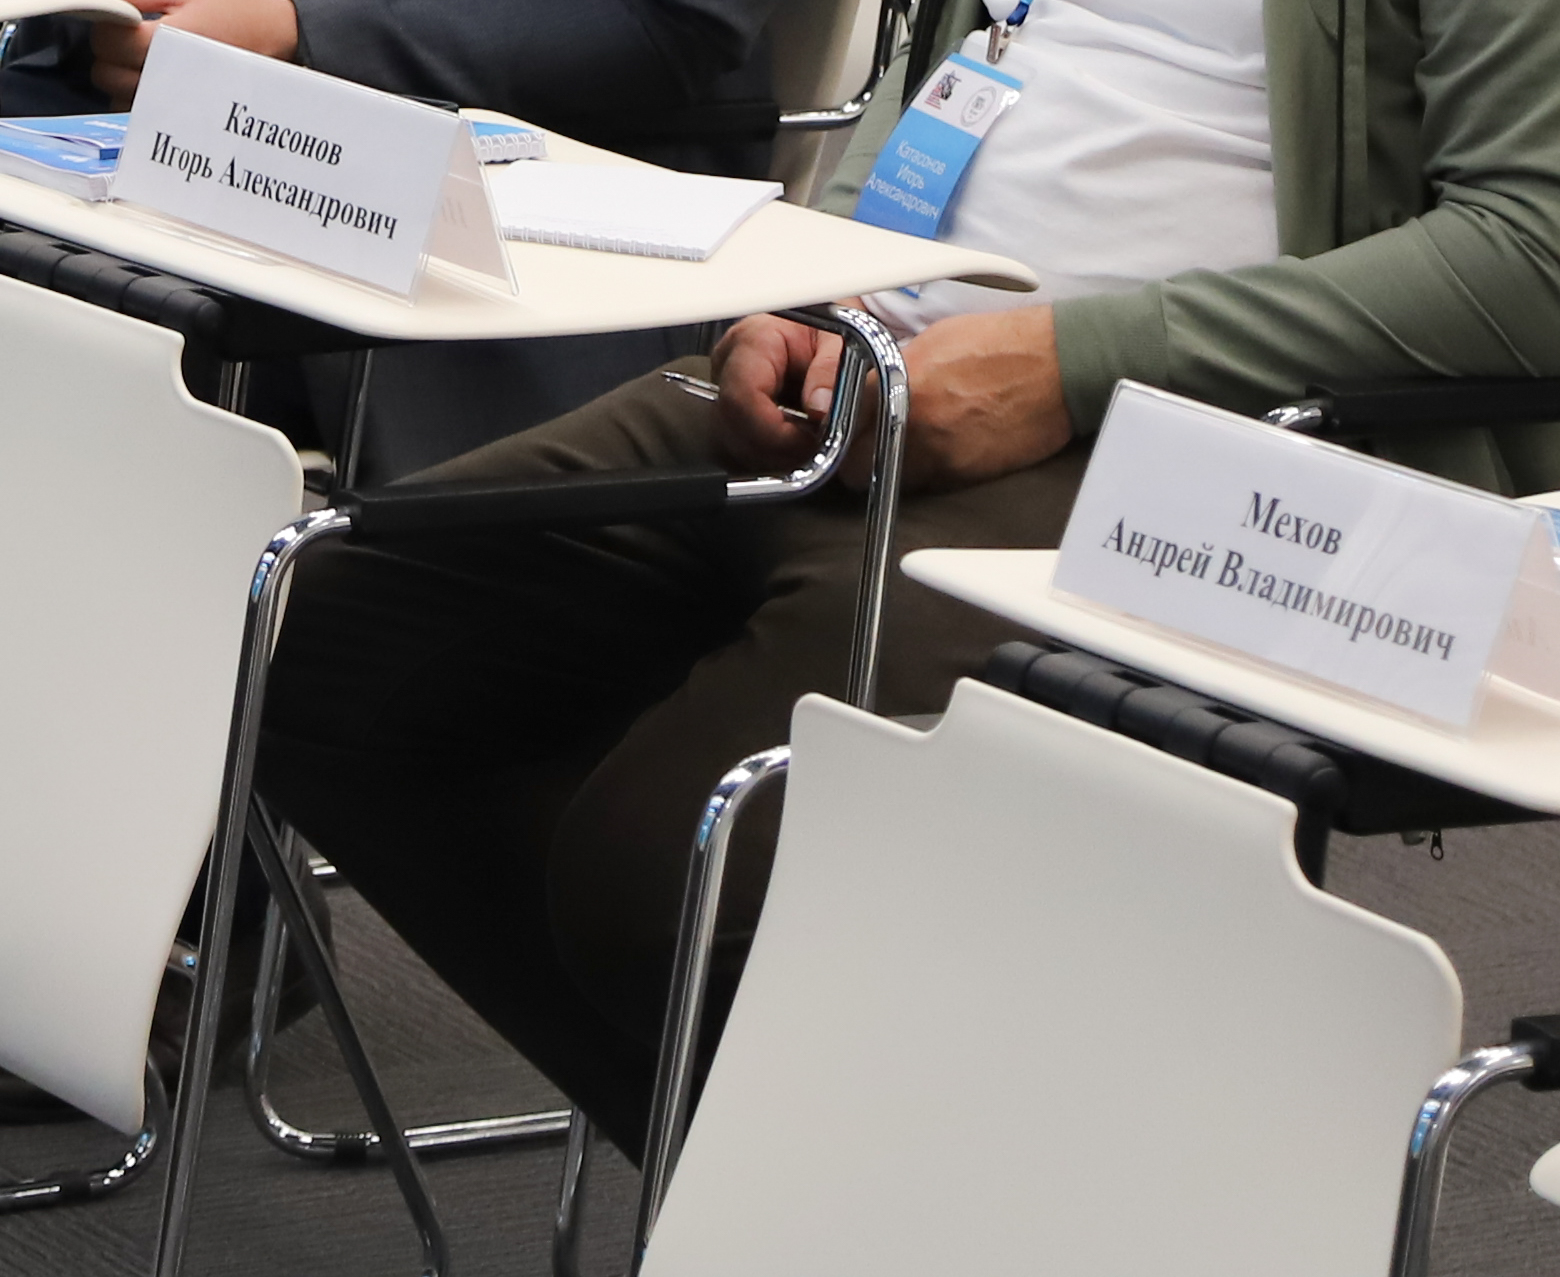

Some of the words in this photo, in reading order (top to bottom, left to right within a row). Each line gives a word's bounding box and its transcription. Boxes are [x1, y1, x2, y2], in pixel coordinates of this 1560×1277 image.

[223, 101, 343, 167] Катасонов
[895, 138, 947, 177] Катасонов
[150, 130, 214, 183] Игорь
[218, 155, 399, 241] Александрович
[865, 172, 940, 221] Александрович
[896, 162, 925, 191] Игорь
[1240, 491, 1343, 557] Мехов
[1102, 516, 1214, 578] Андрей
[1216, 548, 1457, 662] Владимирович
